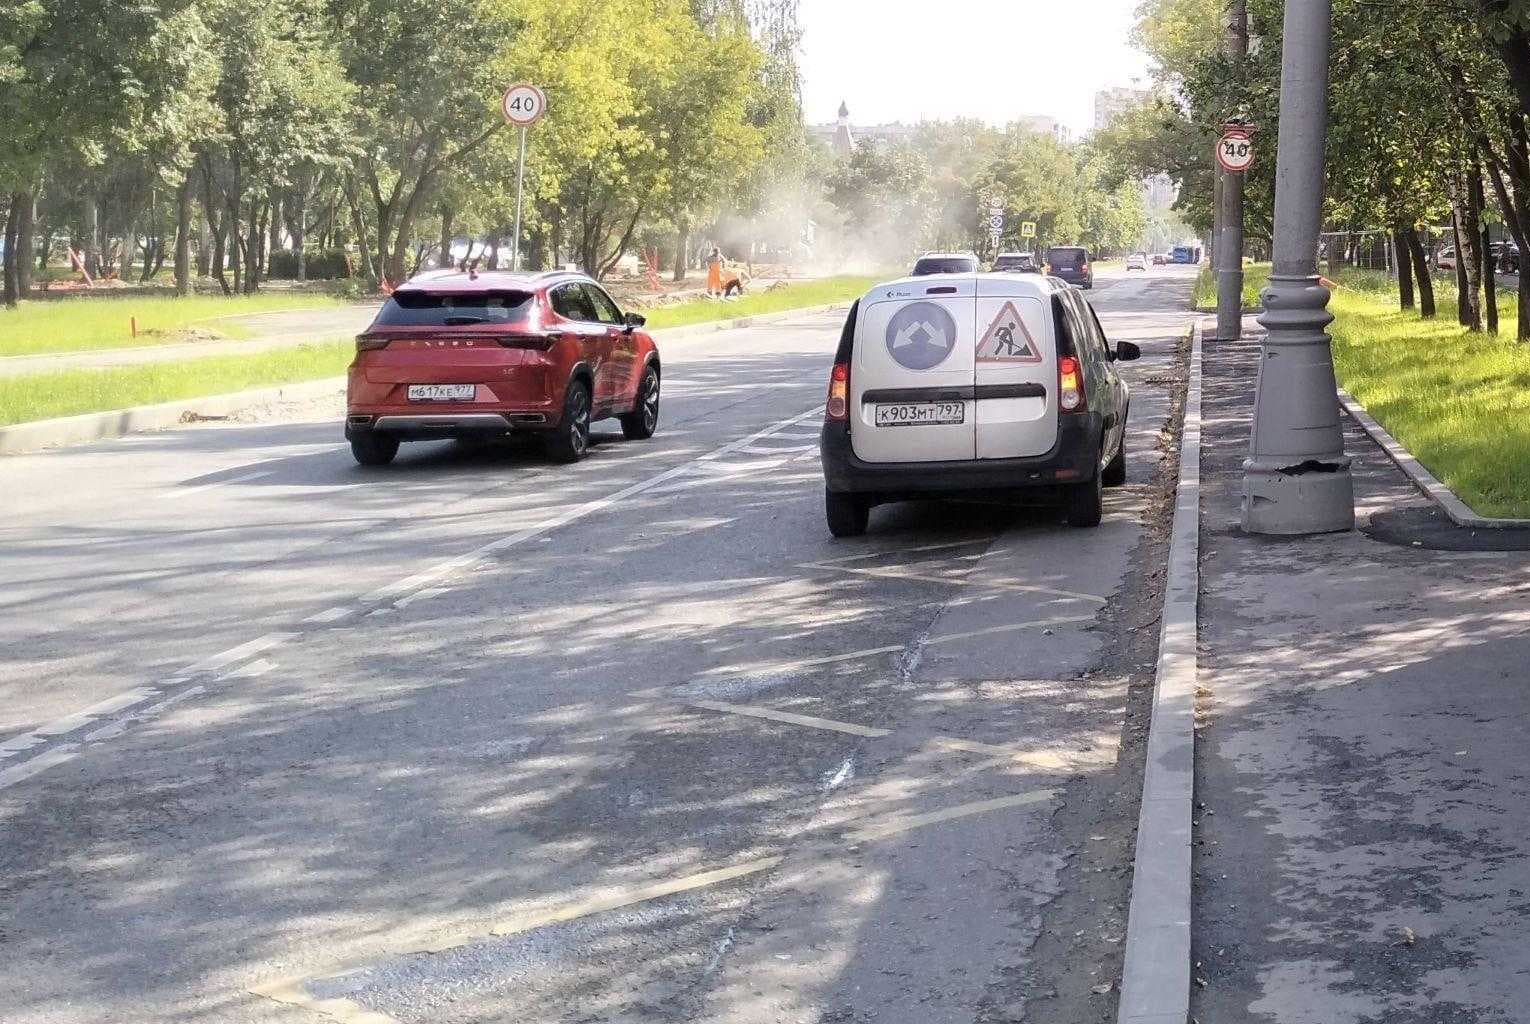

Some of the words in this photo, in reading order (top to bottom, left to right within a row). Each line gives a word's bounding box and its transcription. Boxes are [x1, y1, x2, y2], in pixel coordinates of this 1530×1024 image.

[510, 97, 534, 112] 40
[881, 406, 935, 421] К903МТ
[937, 404, 960, 416] 797
